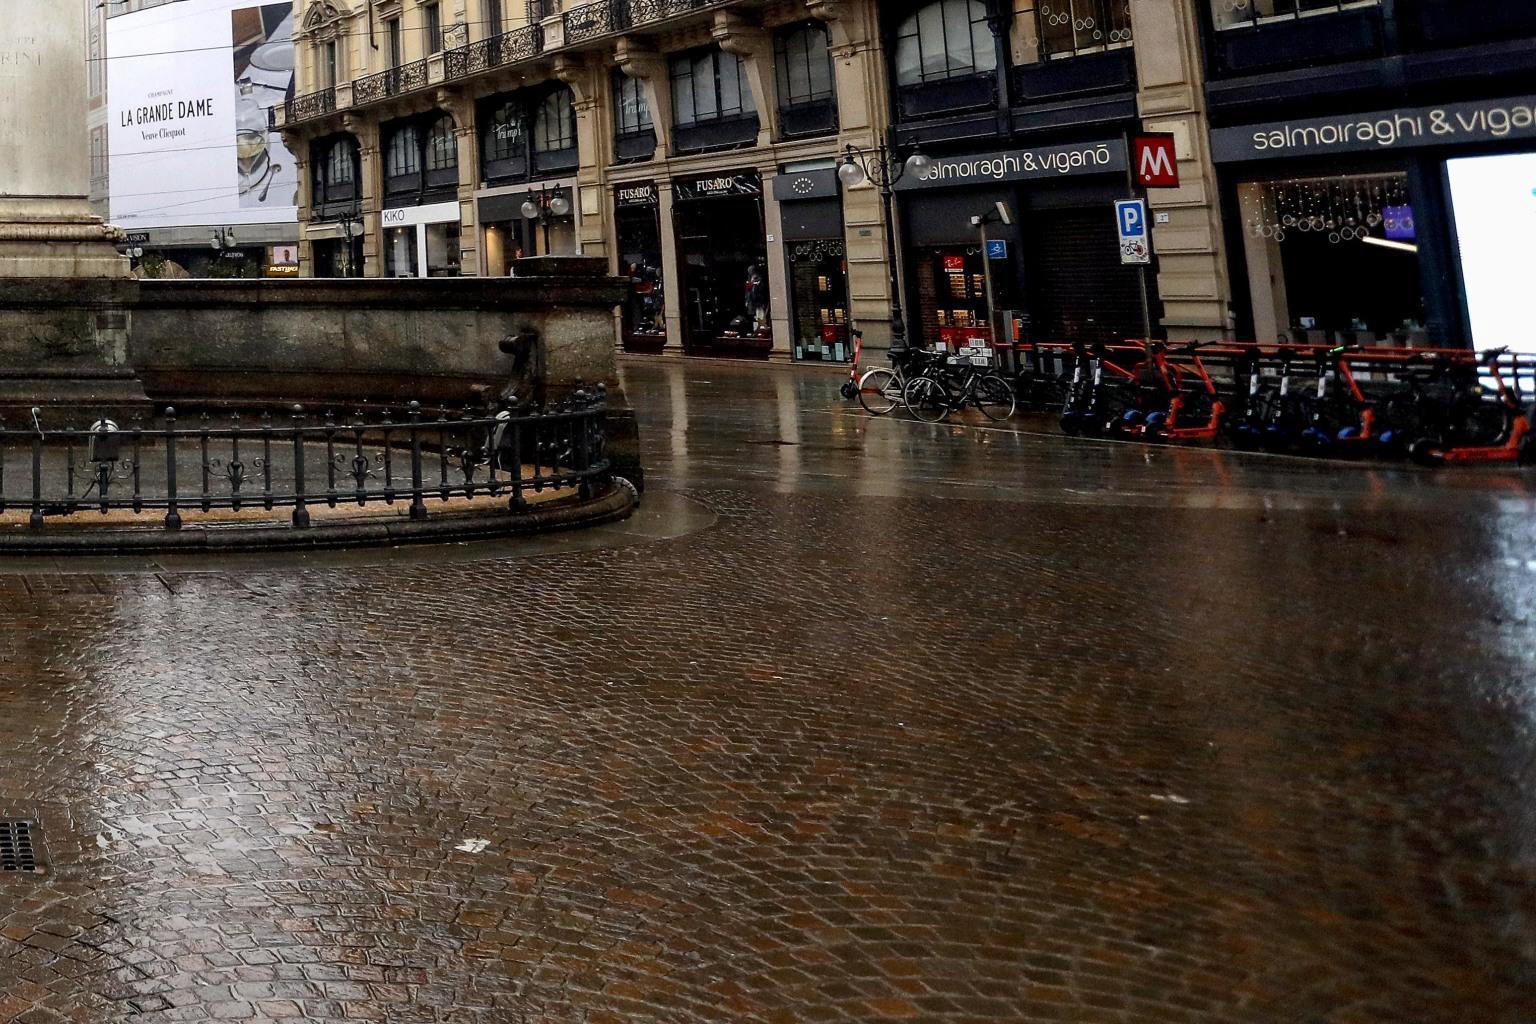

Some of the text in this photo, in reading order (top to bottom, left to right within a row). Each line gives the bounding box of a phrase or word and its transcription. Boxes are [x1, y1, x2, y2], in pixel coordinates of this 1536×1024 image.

[121, 98, 214, 127] LA GRANDE DAME
[141, 127, 186, 141] Veuve Clicquot
[1253, 114, 1423, 150] salmoiraghi
[1429, 109, 1455, 135] &
[1024, 153, 1037, 171] &
[1140, 146, 1174, 176] M
[619, 186, 650, 200] FUSARO
[696, 177, 733, 192] FUSARO
[384, 209, 405, 222] KIKO
[1124, 208, 1138, 232] P
